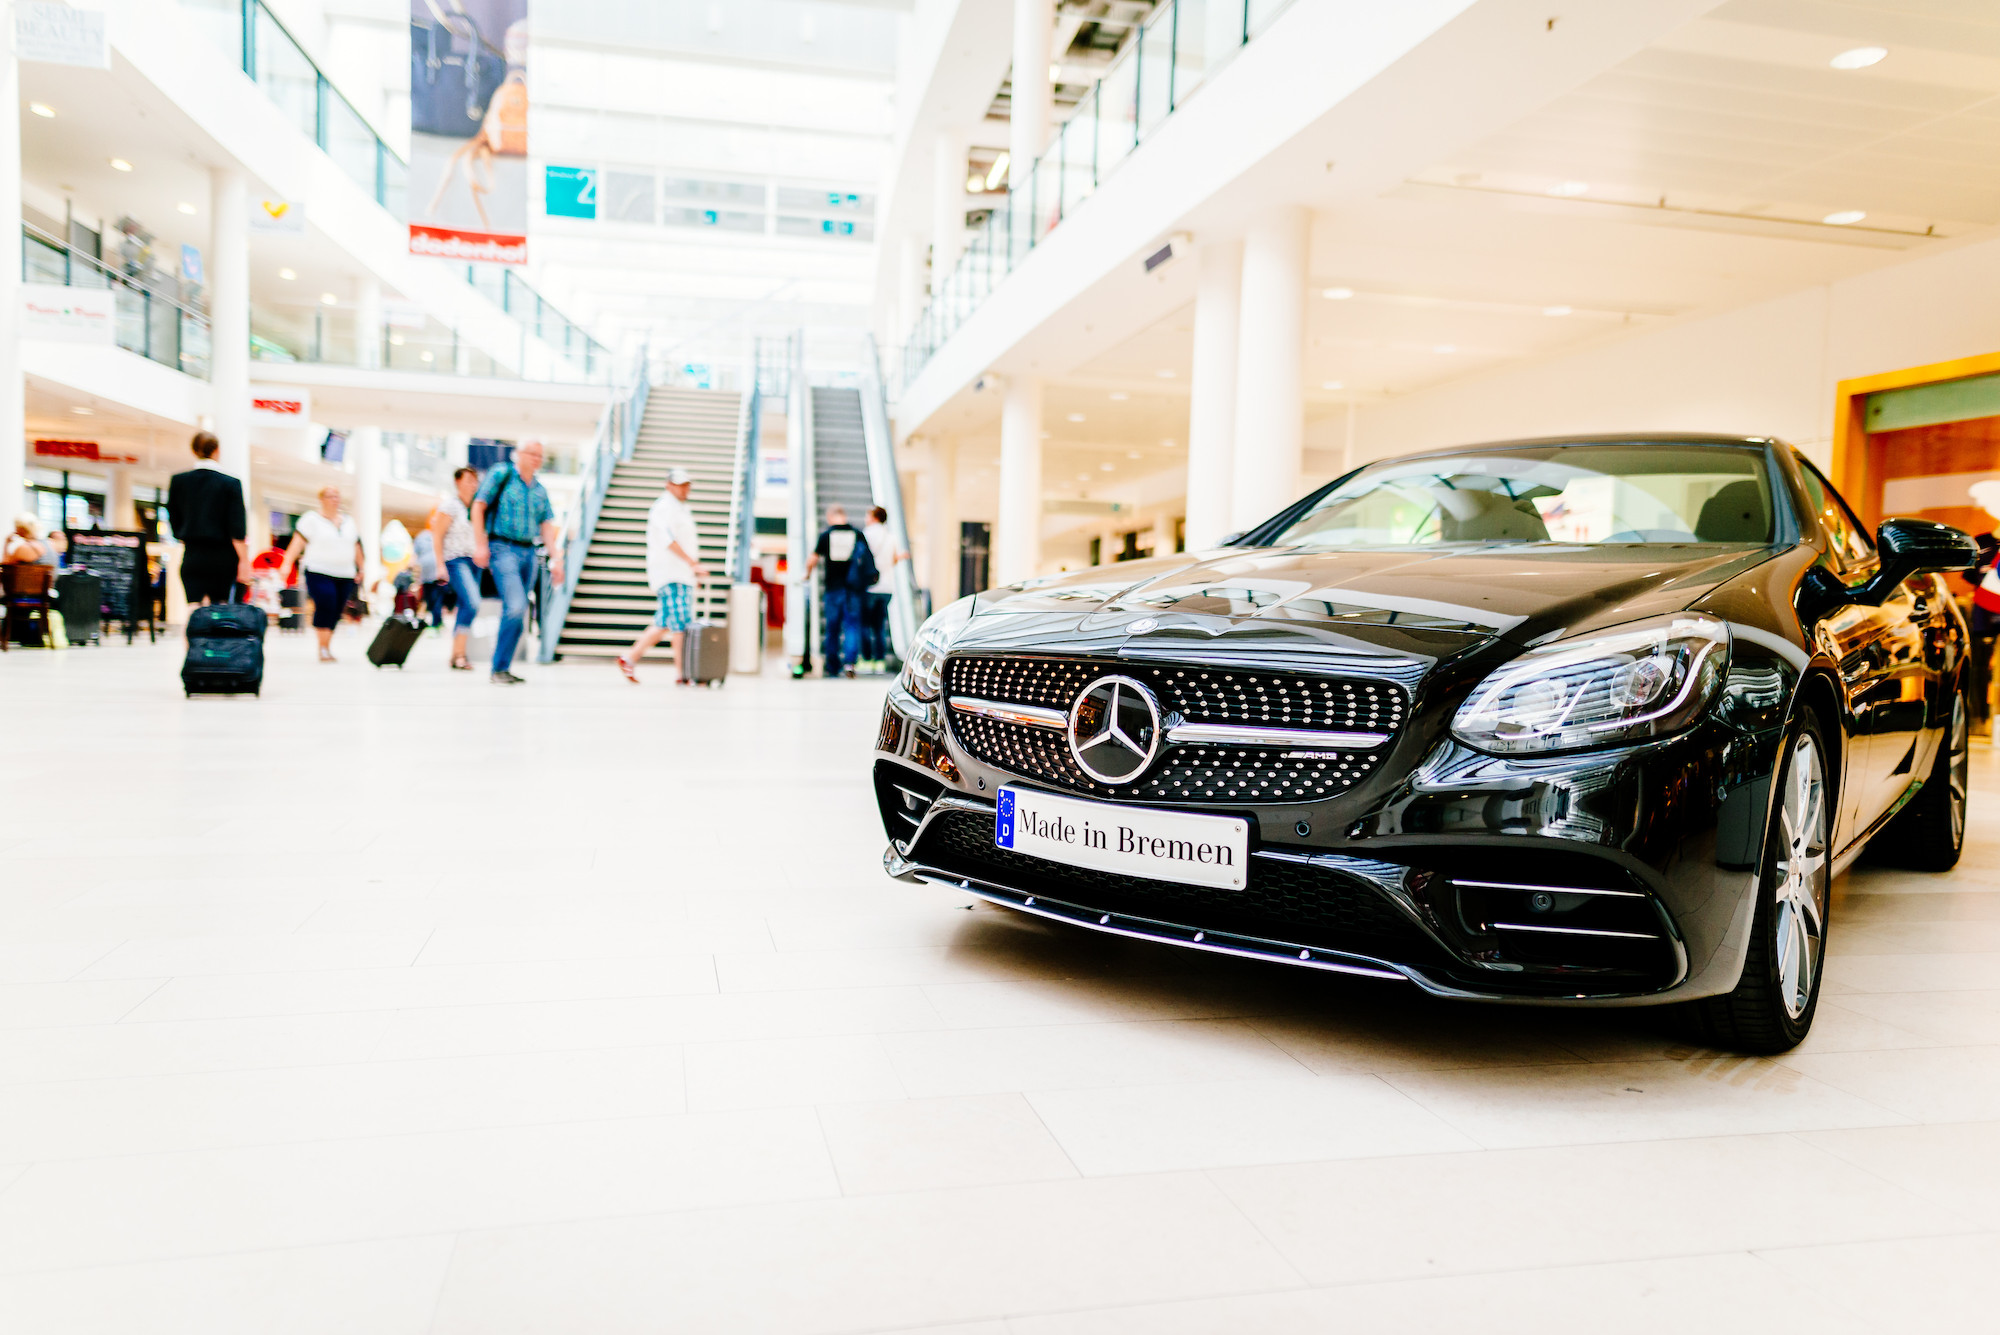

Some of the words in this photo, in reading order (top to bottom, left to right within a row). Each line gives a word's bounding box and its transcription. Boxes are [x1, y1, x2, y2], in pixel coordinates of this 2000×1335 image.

[575, 170, 596, 204] 2
[1002, 823, 1010, 837] D
[1018, 808, 1076, 844] Made
[1083, 821, 1108, 850] in
[1117, 826, 1235, 867] Bremen
